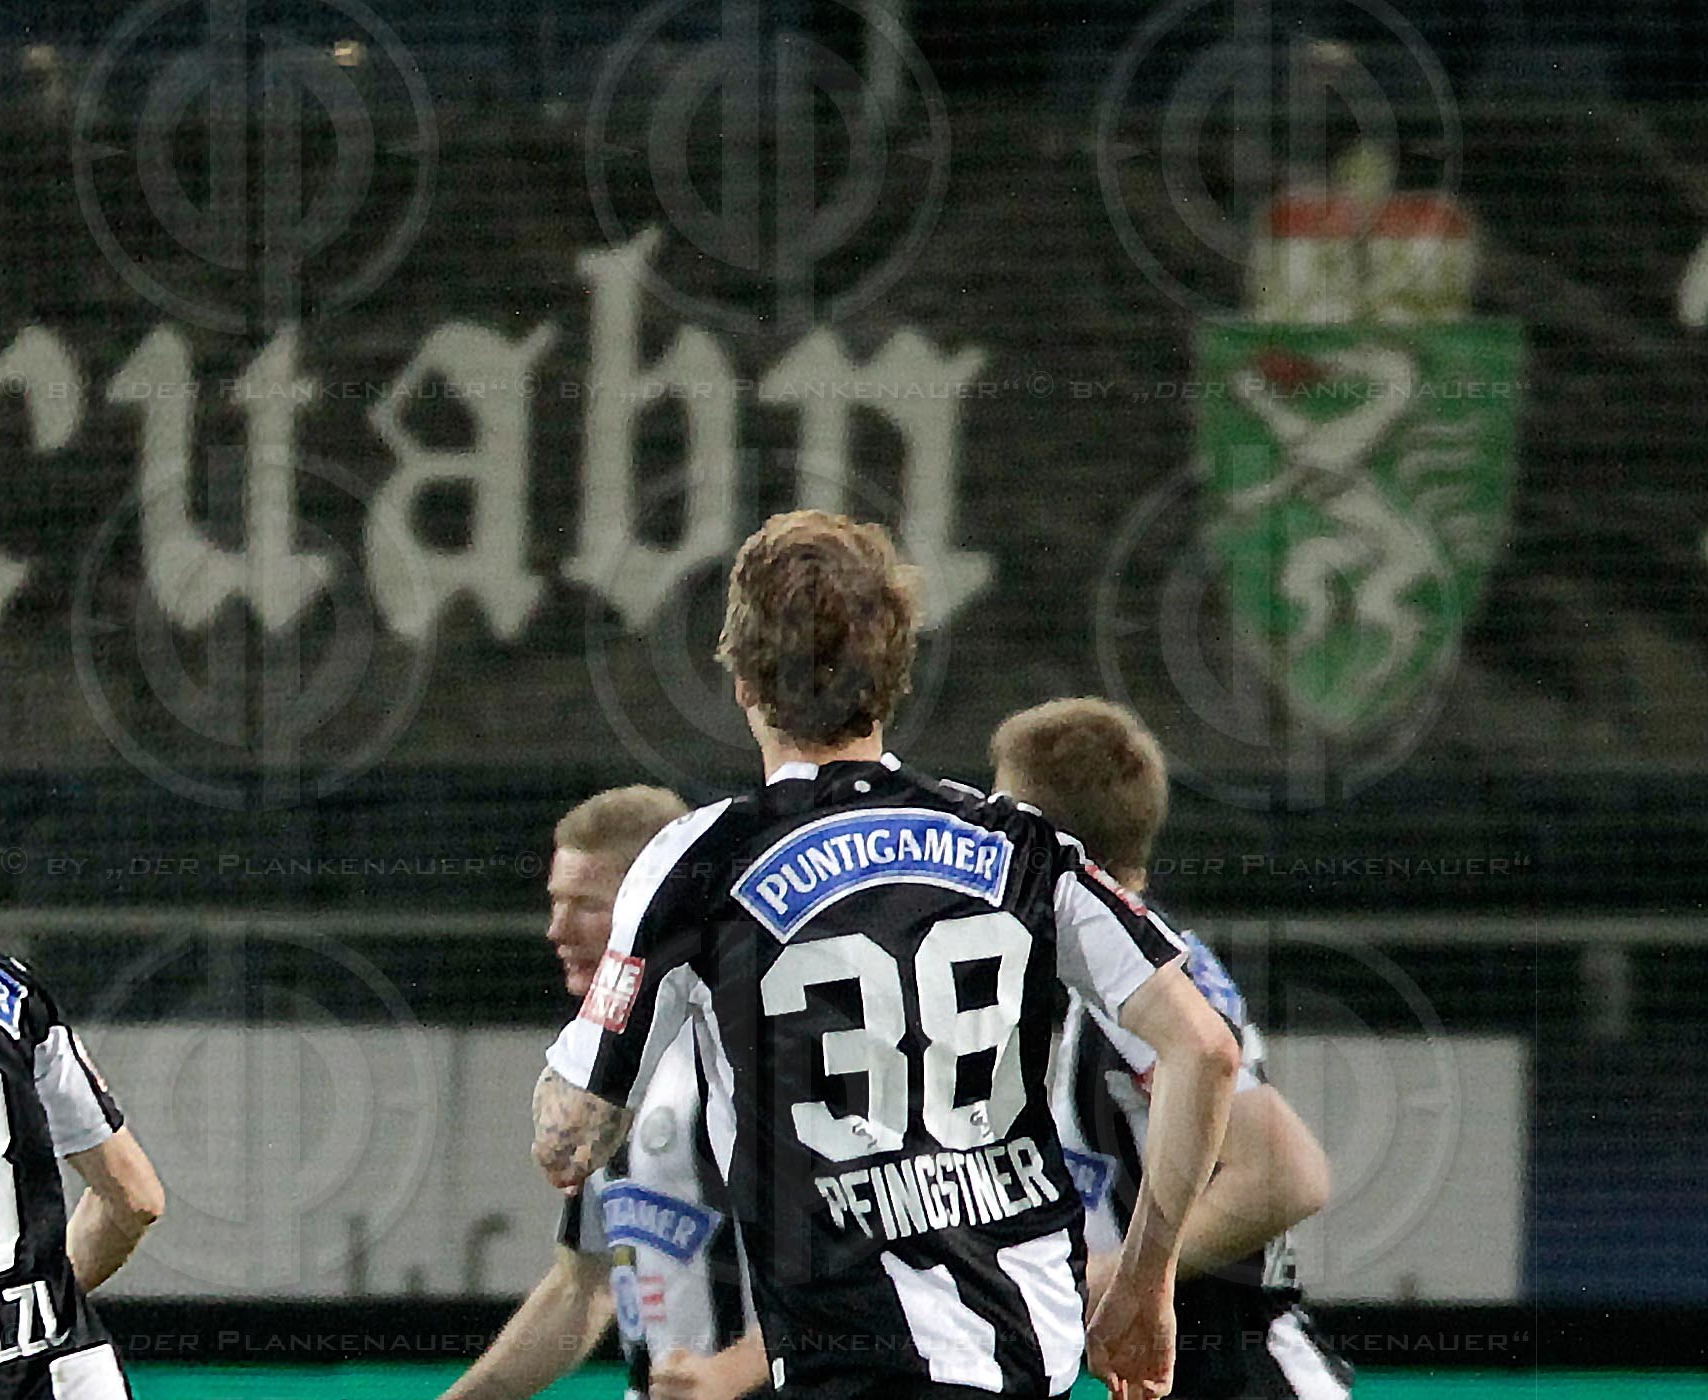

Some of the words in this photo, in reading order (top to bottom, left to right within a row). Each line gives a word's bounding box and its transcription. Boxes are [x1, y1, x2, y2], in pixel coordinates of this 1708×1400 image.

[756, 827, 995, 914] PUNTIGAMER
[760, 911, 1032, 1163] 38
[814, 1136, 1059, 1241] PFINGSTNER
